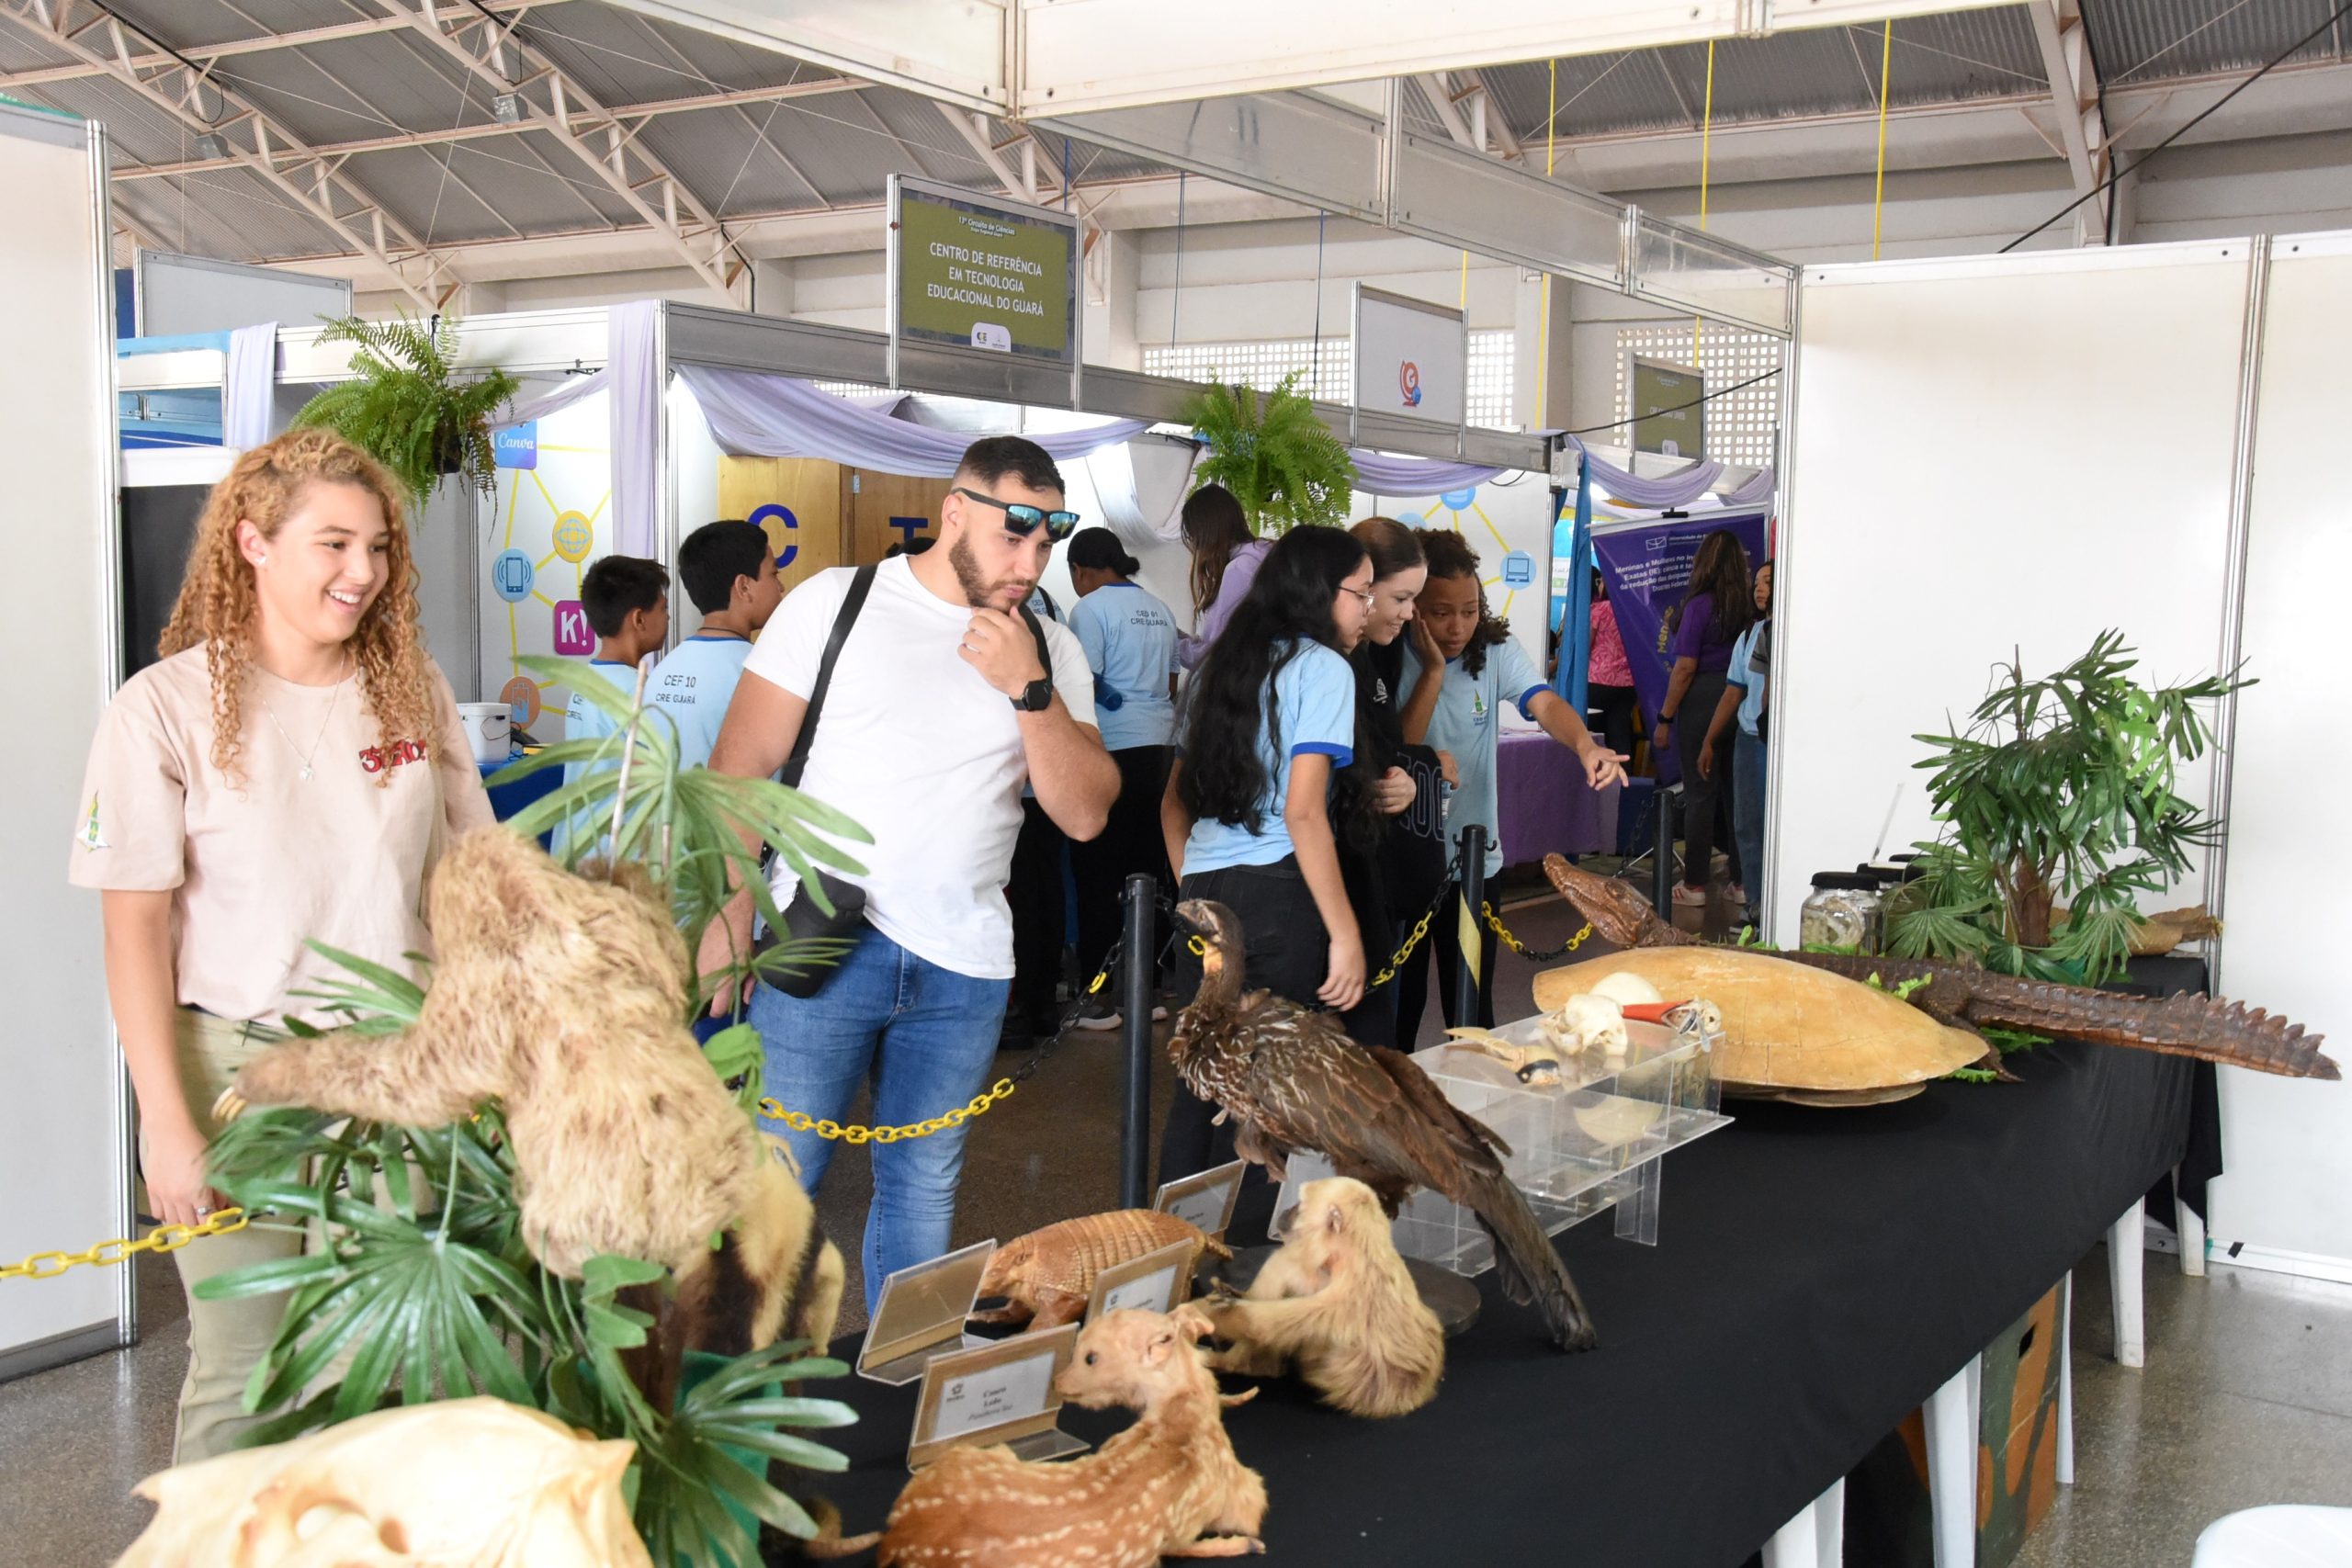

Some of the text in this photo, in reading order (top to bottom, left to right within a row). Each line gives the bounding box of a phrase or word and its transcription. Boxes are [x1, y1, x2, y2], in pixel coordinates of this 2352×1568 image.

[930, 242, 1043, 277] CENTRO DE REFERÊNCIA
[949, 265, 1025, 294] EM TECNOLOGIA
[927, 283, 1045, 317] EDUCACIONAL DO GUARÁ
[498, 433, 535, 450] Canva
[1615, 562, 1645, 574] Meninas
[1624, 569, 1648, 581] Exatas
[1629, 577, 1657, 589] redução
[664, 674, 696, 688] CEF 10
[655, 693, 671, 704] CRE
